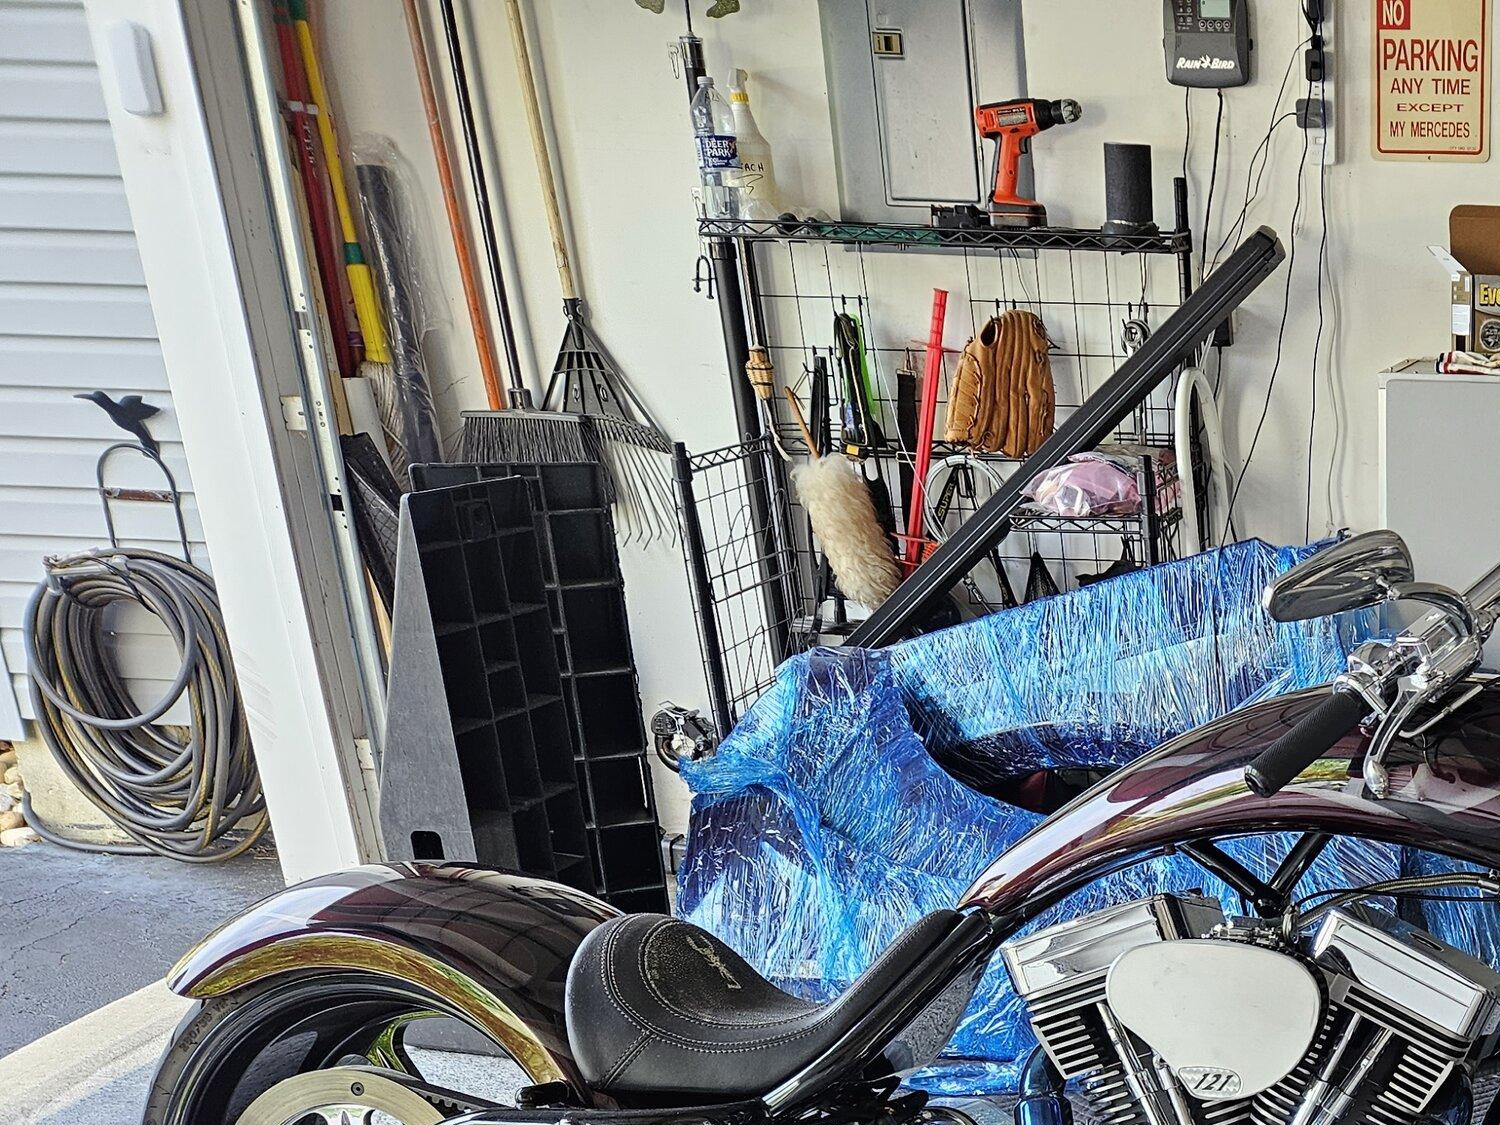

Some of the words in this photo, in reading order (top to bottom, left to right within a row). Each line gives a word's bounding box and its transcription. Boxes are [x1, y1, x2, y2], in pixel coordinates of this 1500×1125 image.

[1383, 0, 1404, 26] NO
[1176, 57, 1202, 69] RAIN
[1210, 57, 1235, 69] BIRD
[1383, 38, 1478, 73] PARKING
[1390, 78, 1424, 94] ANY
[1431, 78, 1471, 95] TIME
[1396, 103, 1464, 112] EXCEPT
[1390, 121, 1406, 138] MY
[1410, 121, 1470, 138] MERCEDES
[705, 140, 729, 149] DEER
[706, 148, 731, 157] PARK
[1193, 1073, 1234, 1092] 121
